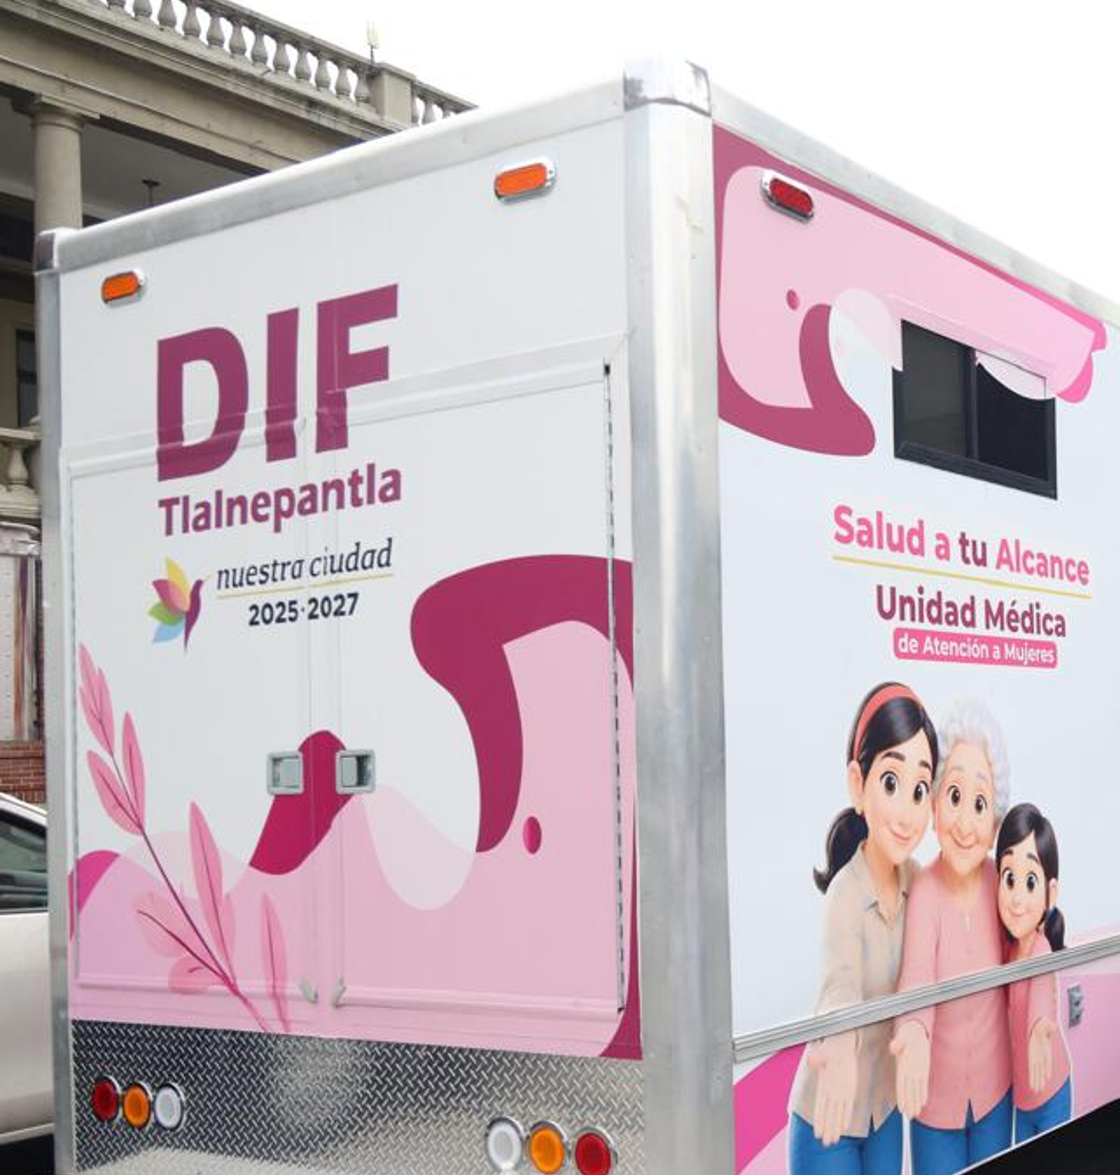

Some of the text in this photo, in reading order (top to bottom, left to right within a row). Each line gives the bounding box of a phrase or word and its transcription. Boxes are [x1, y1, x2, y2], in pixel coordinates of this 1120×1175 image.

[156, 283, 398, 482] DIF
[158, 463, 402, 536] Tlalnepantla
[216, 537, 393, 590] nuestra ciudad
[833, 505, 1090, 586] Salud a tu Alcance
[876, 584, 1067, 638] Unidad Médica
[898, 633, 1056, 666] de Atención a Mujeres
